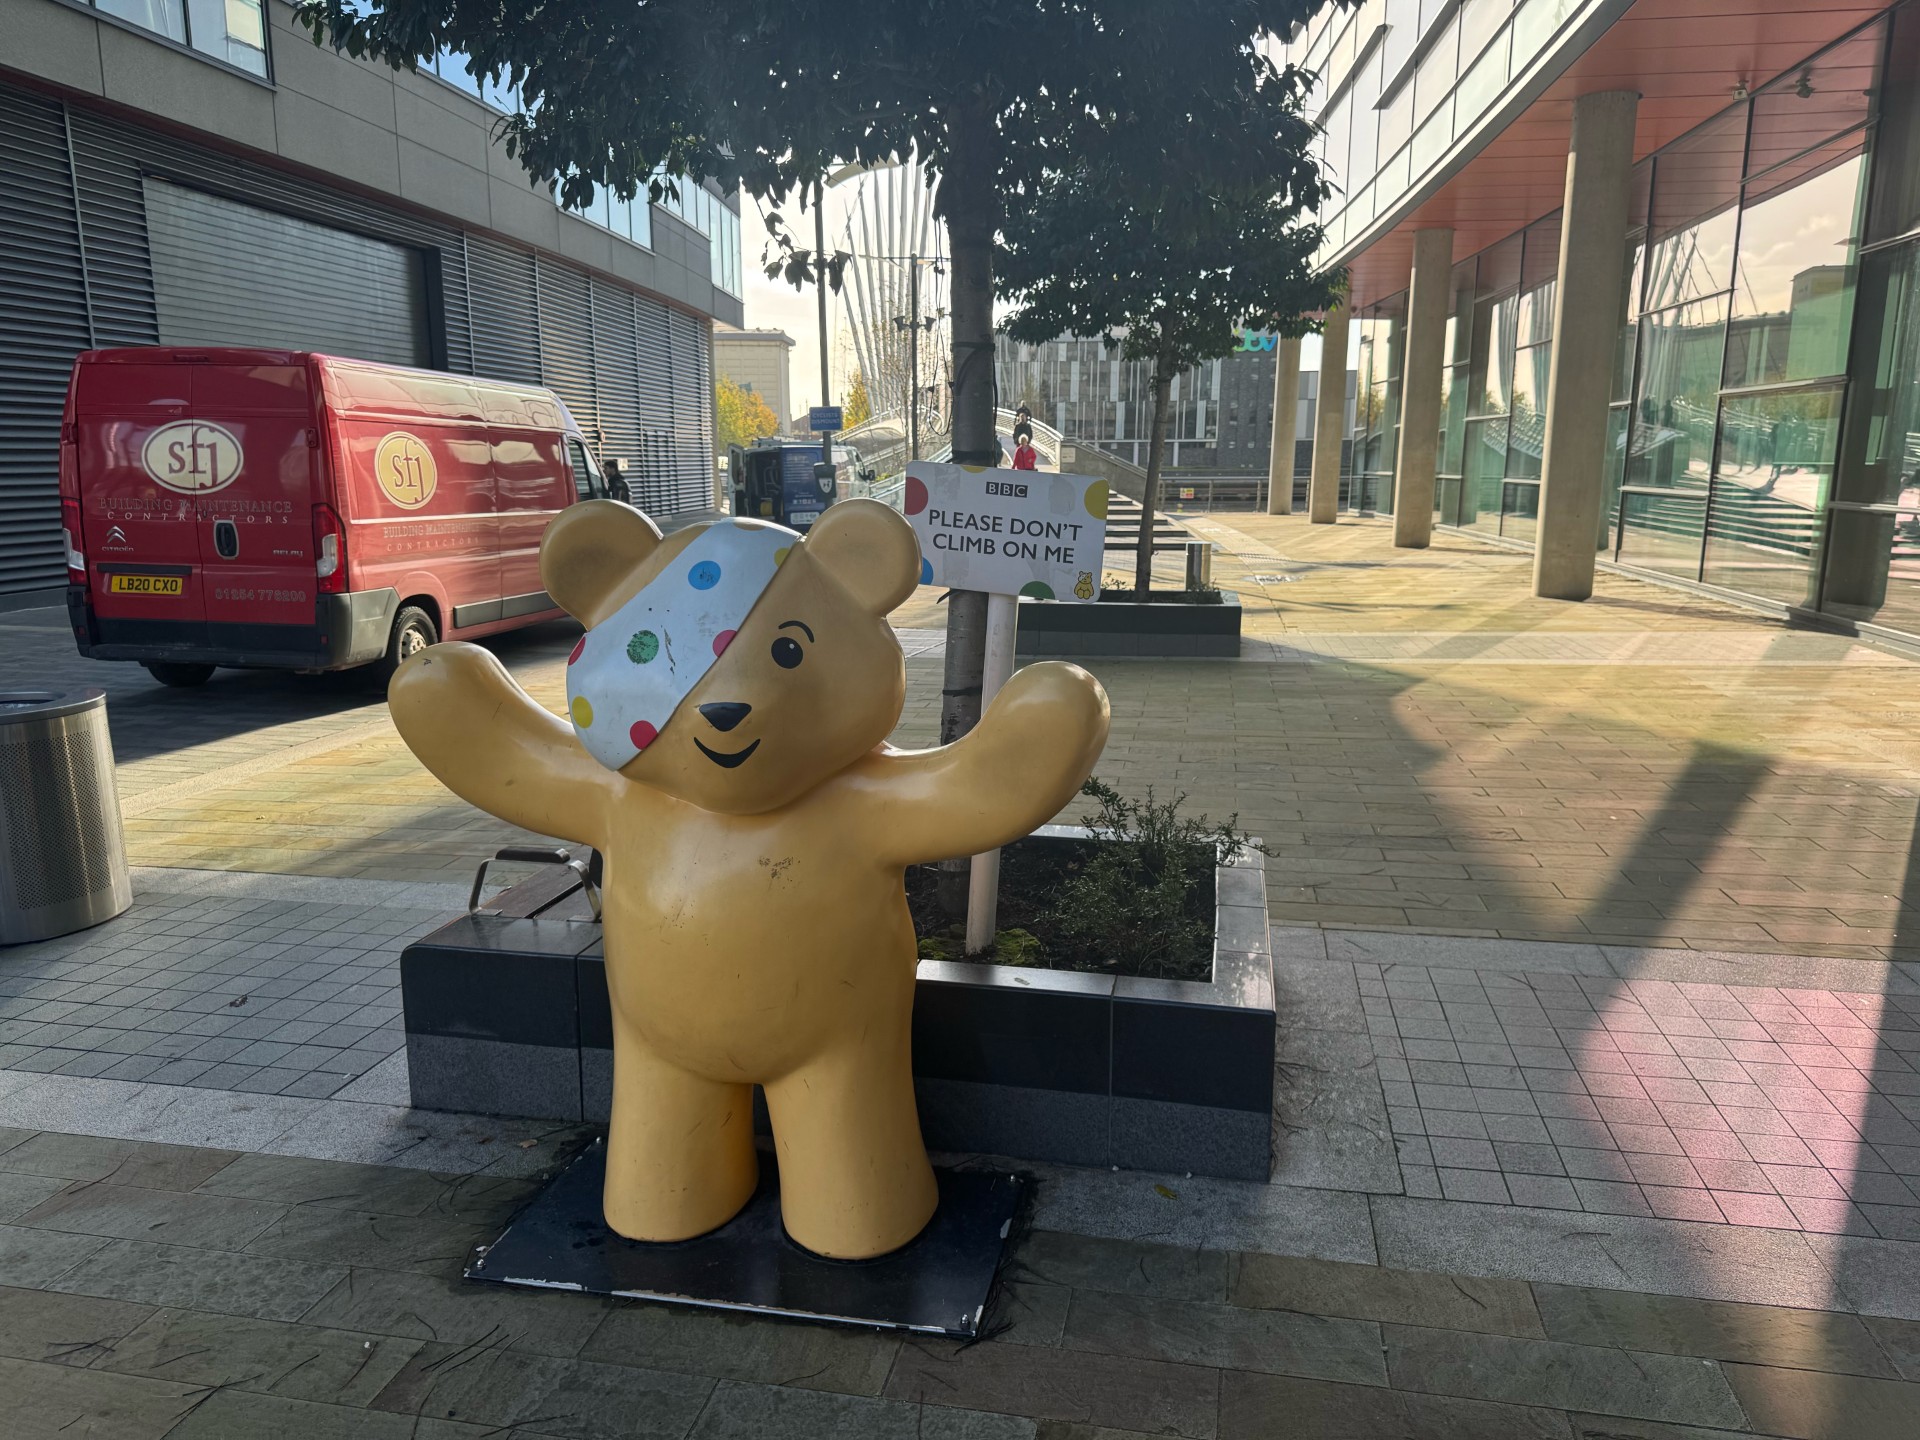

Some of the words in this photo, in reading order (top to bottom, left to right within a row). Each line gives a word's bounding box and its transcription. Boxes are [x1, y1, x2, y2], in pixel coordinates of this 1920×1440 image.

[986, 481, 1028, 498] BBC
[100, 498, 173, 511] BUILDING
[179, 500, 293, 513] MAINTENANCE
[107, 511, 288, 523] CONTRACTORS
[383, 525, 424, 538] BUILDING
[929, 509, 1003, 533] PLEASE
[1010, 518, 1083, 541] DON'T
[933, 533, 996, 555] CLIMB
[1003, 541, 1037, 559] ON
[1045, 546, 1075, 564] ME
[118, 577, 149, 591] LB20
